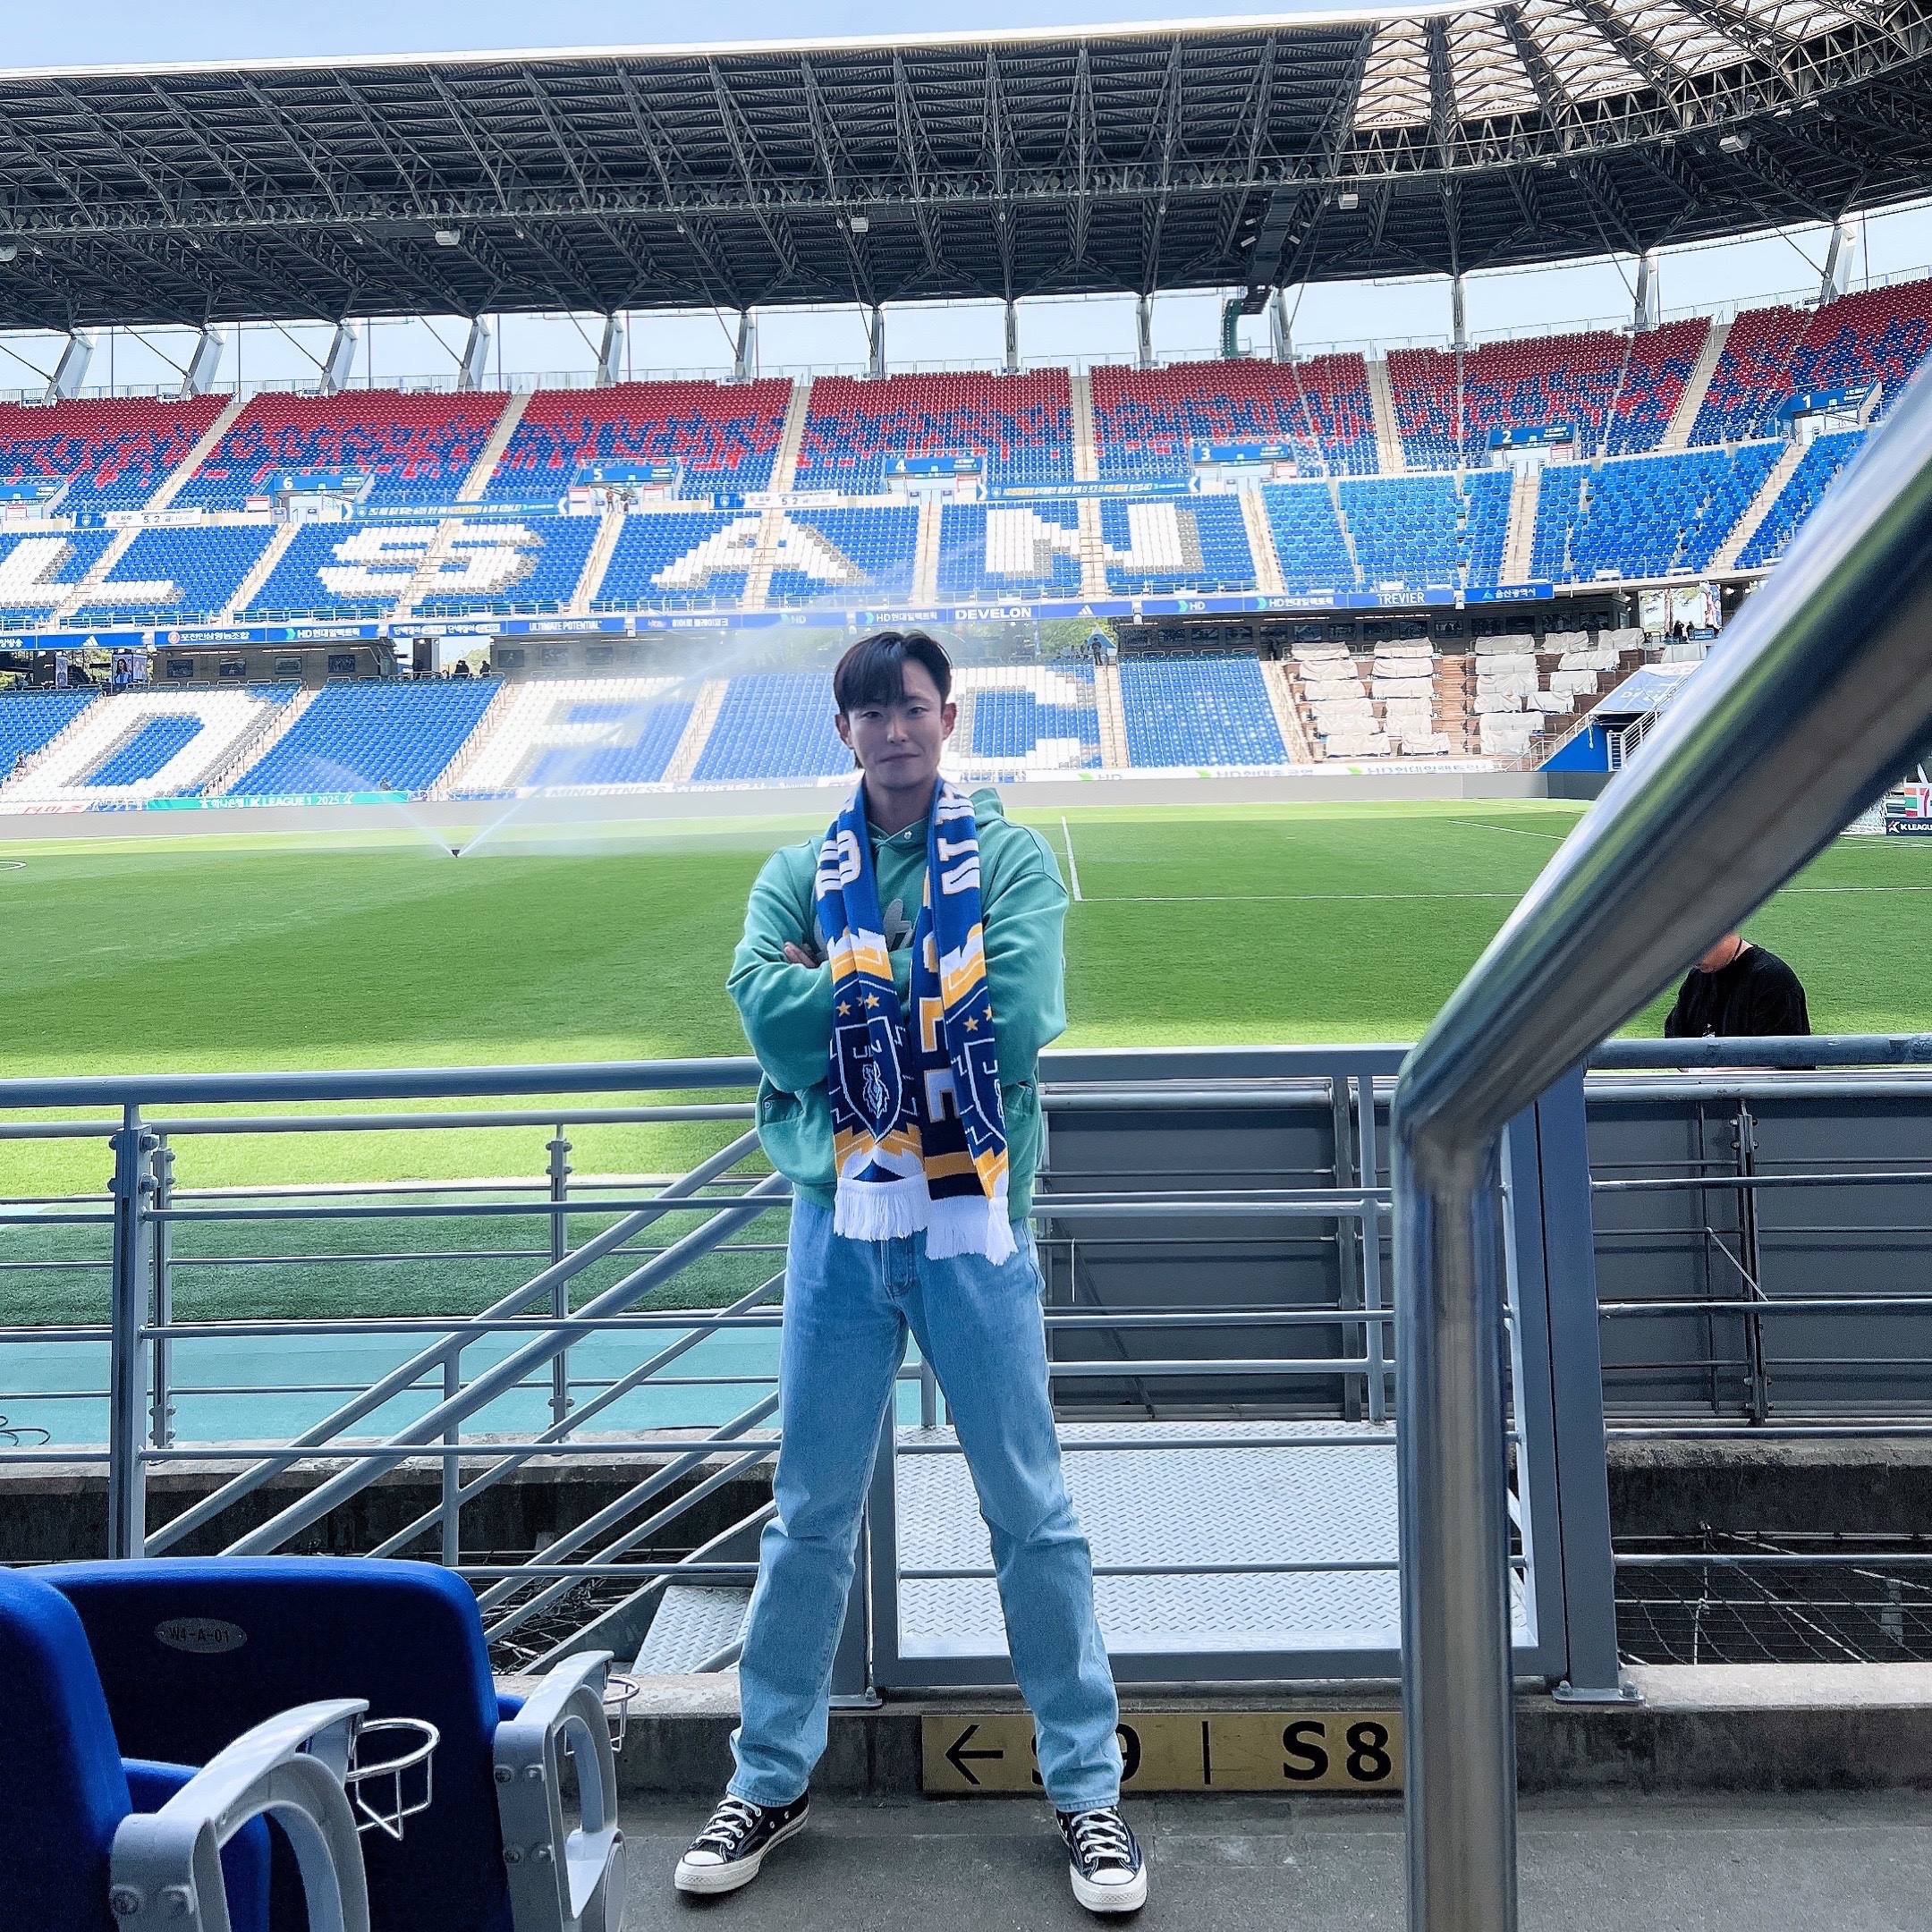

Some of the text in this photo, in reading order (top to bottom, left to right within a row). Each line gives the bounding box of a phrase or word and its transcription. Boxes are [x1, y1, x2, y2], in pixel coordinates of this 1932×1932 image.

[1802, 394, 1811, 409] 1
[1503, 430, 1513, 443] 2
[1201, 447, 1211, 461] 3
[895, 459, 906, 472] 4
[593, 468, 603, 481] 5
[283, 477, 293, 489] 6
[154, 515, 161, 523] 2
[1377, 592, 1426, 606] TREVIER
[1495, 587, 1537, 598] 울산광역시
[1190, 602, 1206, 610] HD
[791, 614, 807, 623] HD
[954, 606, 1032, 621] DEVELON
[529, 620, 563, 631] ULTIMATE
[597, 784, 667, 796] FITNESS
[262, 796, 306, 807] LEAGUE
[317, 795, 340, 805] 2025
[169, 1626, 230, 1644] W4-A-01
[1281, 1719, 1393, 1783] S8
